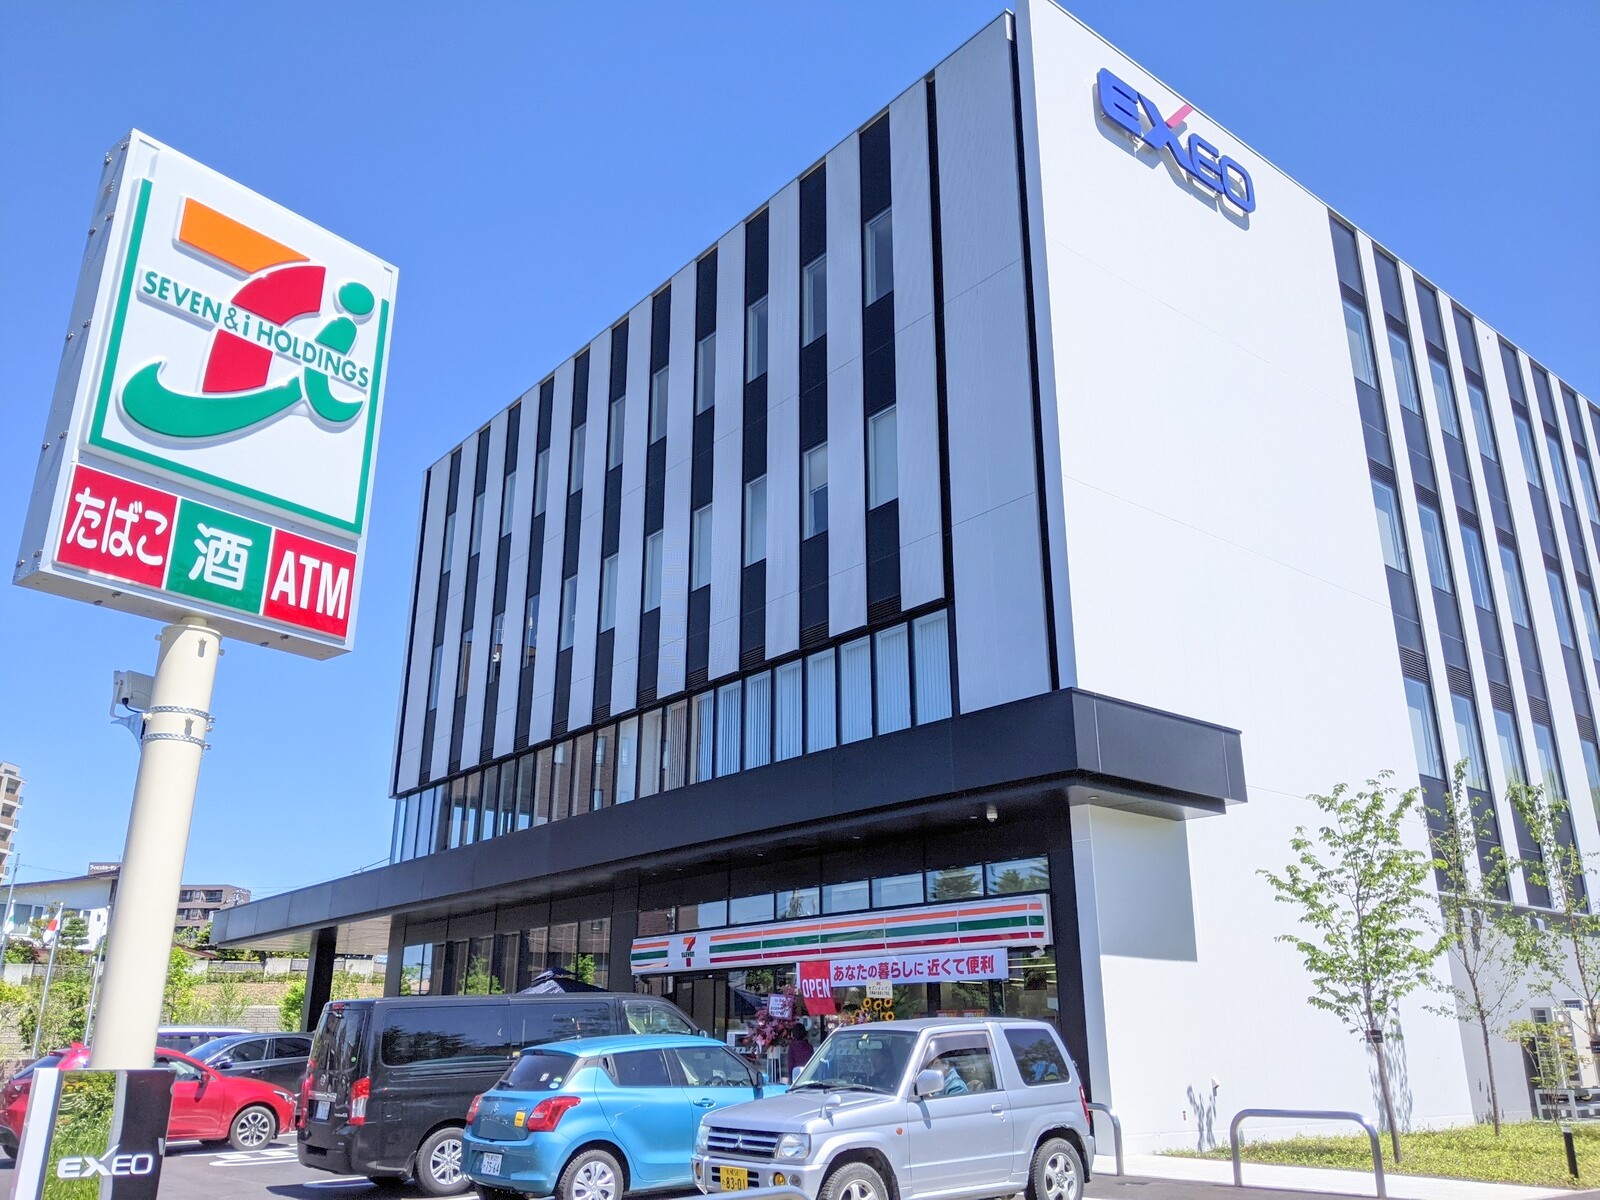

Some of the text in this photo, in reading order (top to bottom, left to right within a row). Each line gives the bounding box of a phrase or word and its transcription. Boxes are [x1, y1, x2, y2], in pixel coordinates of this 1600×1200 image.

[1097, 68, 1256, 213] EXEO
[256, 321, 369, 388] HOLDINGS
[66, 487, 168, 566] たばこ
[188, 523, 252, 591] 酒
[270, 550, 350, 620] ATM
[801, 978, 831, 999] OPEN
[833, 955, 995, 981] あなたの暮らしに 近くて便利
[57, 1144, 153, 1178] EXEO
